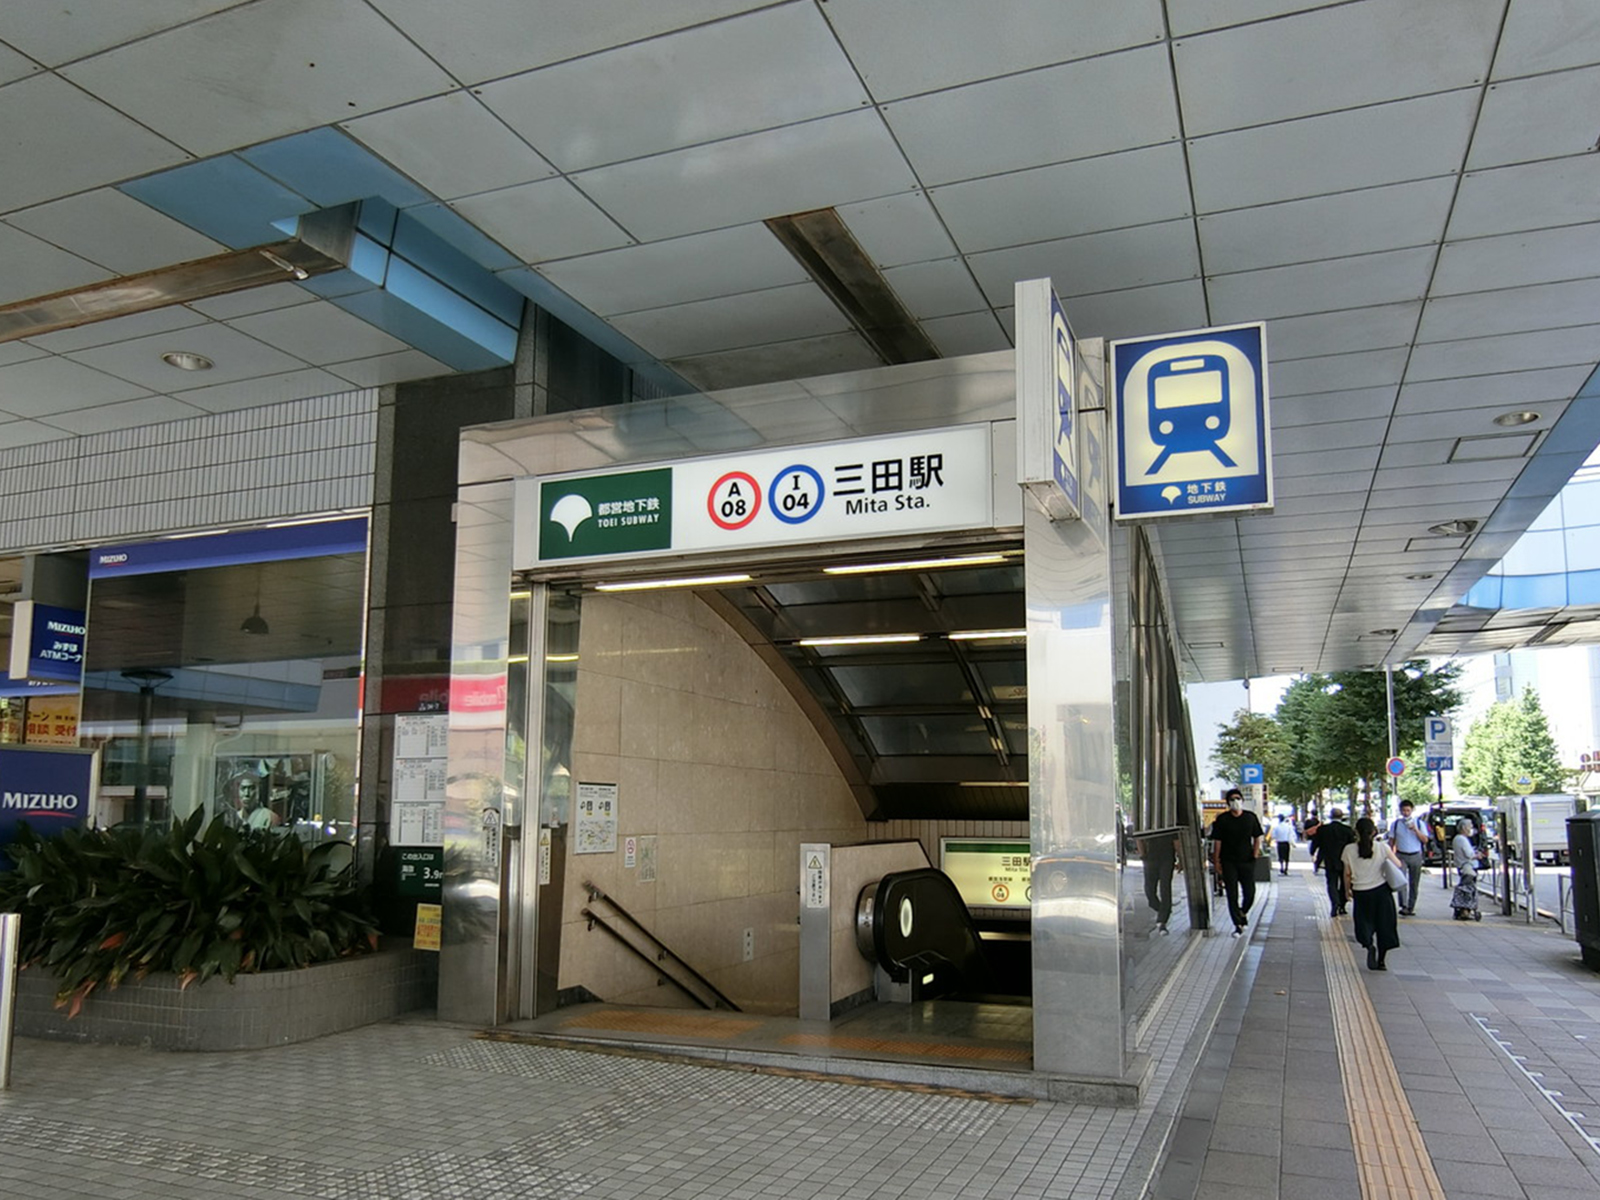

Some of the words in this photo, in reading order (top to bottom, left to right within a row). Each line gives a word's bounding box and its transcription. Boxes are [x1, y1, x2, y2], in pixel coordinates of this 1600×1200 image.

[793, 475, 800, 490] I
[833, 454, 944, 496] 三田駅
[728, 482, 741, 497] A
[1187, 481, 1226, 494] 地下鉄
[783, 493, 809, 511] 04
[846, 498, 887, 515] Mita
[895, 494, 930, 511] Sta.
[1188, 493, 1226, 504] SUBWAY
[598, 497, 660, 516] 都営地下鉄
[721, 499, 746, 517] 08
[598, 518, 618, 528] TOEI
[621, 513, 659, 526] SUBWAY
[99, 554, 128, 563] MIZUHO
[47, 621, 86, 635] MIZUHO
[53, 641, 78, 652] みずほ
[1430, 720, 1446, 740] P
[1244, 767, 1259, 782] P
[2, 792, 78, 810] MIZUHO
